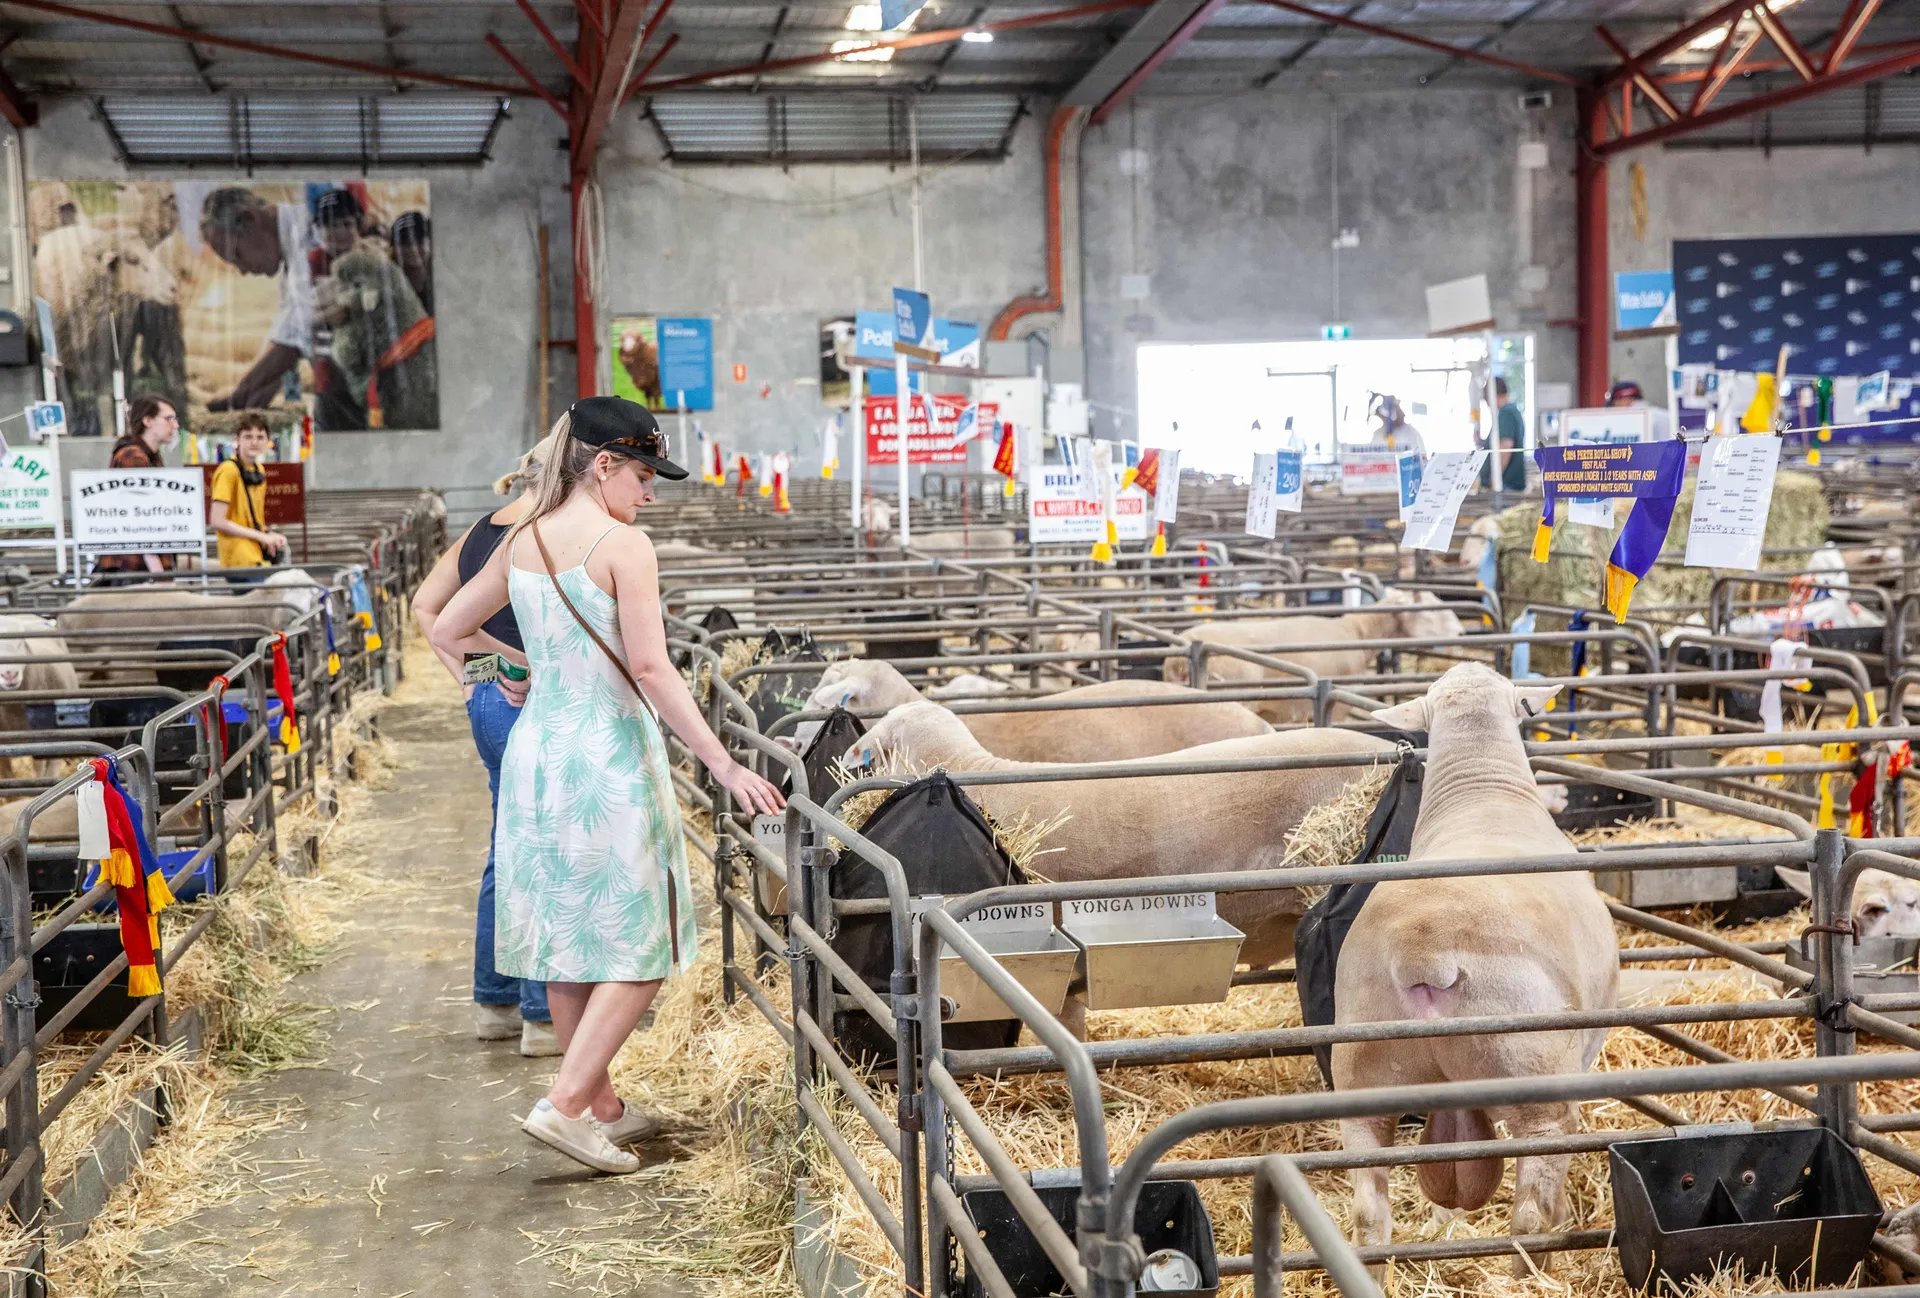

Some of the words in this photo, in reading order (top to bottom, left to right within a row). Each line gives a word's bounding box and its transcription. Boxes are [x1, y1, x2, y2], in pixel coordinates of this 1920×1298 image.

[862, 328, 893, 347] Poll
[1577, 450, 1593, 460] PERTH
[1594, 449, 1610, 459] ROYAL
[1611, 448, 1627, 459] SHOW
[13, 455, 49, 481] ARY
[1582, 461, 1592, 469] FIRST
[1593, 460, 1606, 469] PLACE
[1556, 471, 1573, 481] SUFFOLK
[1585, 471, 1599, 480] UNDER
[1612, 471, 1627, 480] YEARS
[1628, 470, 1641, 480] WITH
[80, 477, 196, 498] RIDGETOP
[1614, 483, 1633, 492] SUFFOLK
[85, 506, 128, 517] White
[134, 506, 193, 517] Suffolks
[89, 526, 118, 534] Flock
[123, 524, 168, 534] Number
[761, 823, 786, 835] YO
[1071, 899, 1134, 914] YONGA
[1142, 894, 1207, 911] DOWNS
[978, 905, 1044, 921] DOWNS
